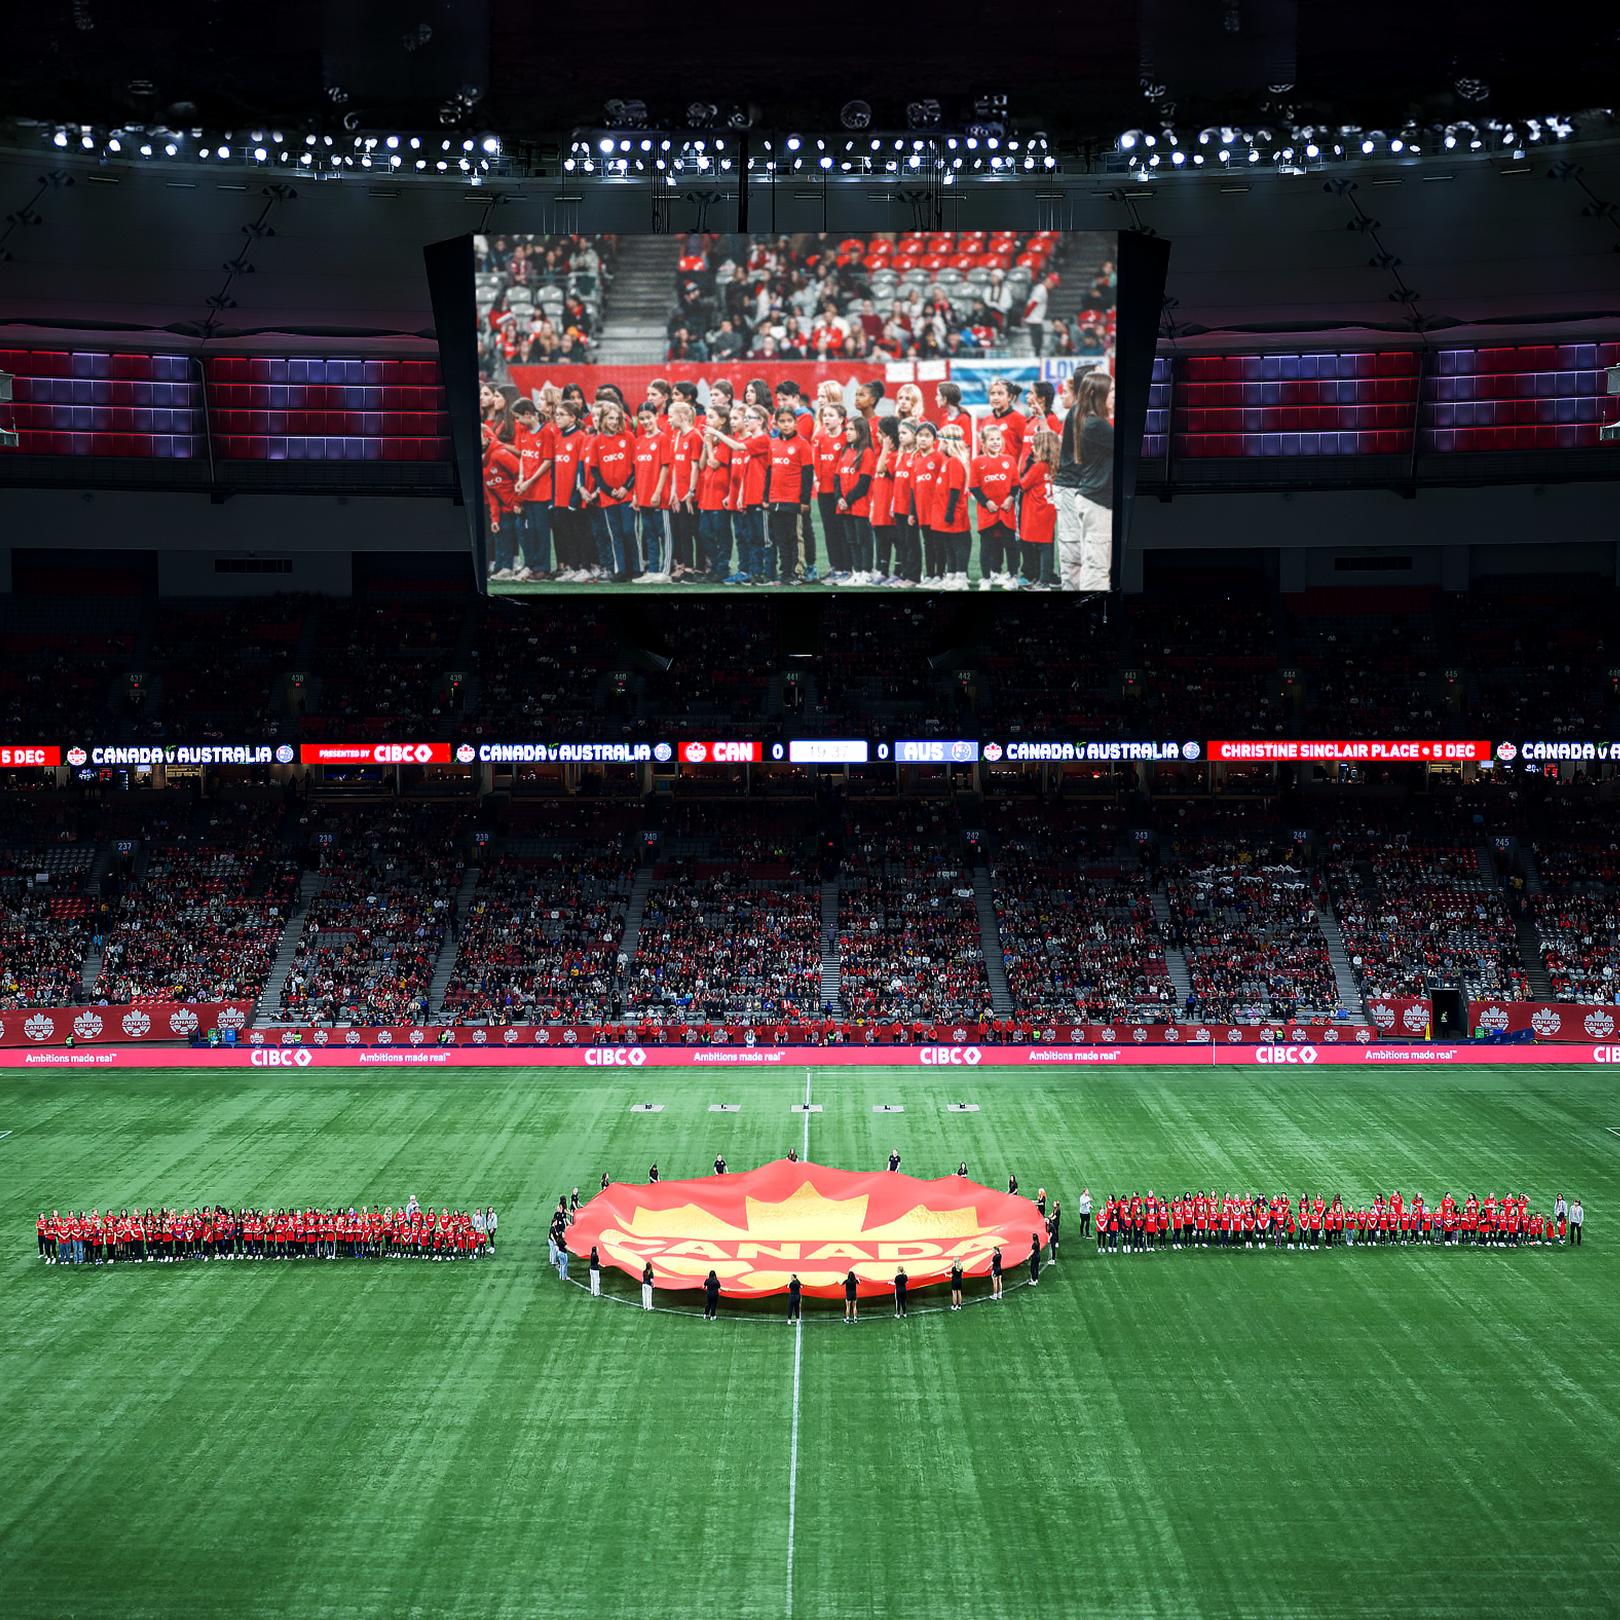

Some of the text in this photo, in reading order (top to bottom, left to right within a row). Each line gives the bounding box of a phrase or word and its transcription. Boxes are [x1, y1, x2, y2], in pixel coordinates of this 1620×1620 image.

[129, 675, 143, 683] 437
[449, 674, 463, 682] 439
[786, 673, 799, 681] 441
[958, 672, 971, 680] 442
[1444, 670, 1458, 678] 445
[92, 747, 164, 764] CANADA
[177, 746, 272, 763] AUSTRALIA
[319, 749, 370, 758] PRESENTED BY
[374, 745, 414, 763] CIBC
[480, 745, 547, 761] CANADA
[559, 744, 651, 761] AUSTRALIA
[713, 744, 753, 761] CAN
[773, 744, 784, 760] 0
[809, 745, 850, 759] 1937
[878, 744, 889, 760] 0
[904, 742, 944, 760] AUS
[1006, 743, 1074, 760] CANADA
[1087, 742, 1179, 760] AUSTRALIA
[1221, 744, 1475, 758] CHRISTINE SINCLAIR PLACE 5 DEC
[1522, 743, 1595, 760] CANADA
[1, 750, 45, 763] 5 DEC
[319, 834, 332, 843] 238
[475, 833, 489, 841] 239
[643, 832, 657, 840] 240
[966, 831, 979, 839] 242
[1134, 831, 1148, 839] 243
[1293, 831, 1306, 839] 244
[118, 842, 132, 851] 237
[1495, 838, 1509, 847] 245
[26, 1054, 70, 1063] Ambitions
[71, 1054, 95, 1063] made
[251, 1049, 293, 1066] CIBC
[359, 1053, 403, 1062] Ambitions
[405, 1053, 428, 1062] made
[585, 1048, 627, 1065] CIBC
[694, 1052, 738, 1062] Ambitions
[739, 1052, 764, 1062] made
[920, 1047, 962, 1064] CIBC
[1029, 1051, 1073, 1060] Ambitions
[1075, 1051, 1099, 1060] made
[1256, 1046, 1298, 1063] CIBC
[1365, 1050, 1409, 1060] Ambitions
[1411, 1050, 1435, 1060] made
[599, 1229, 1010, 1259] CANADA
